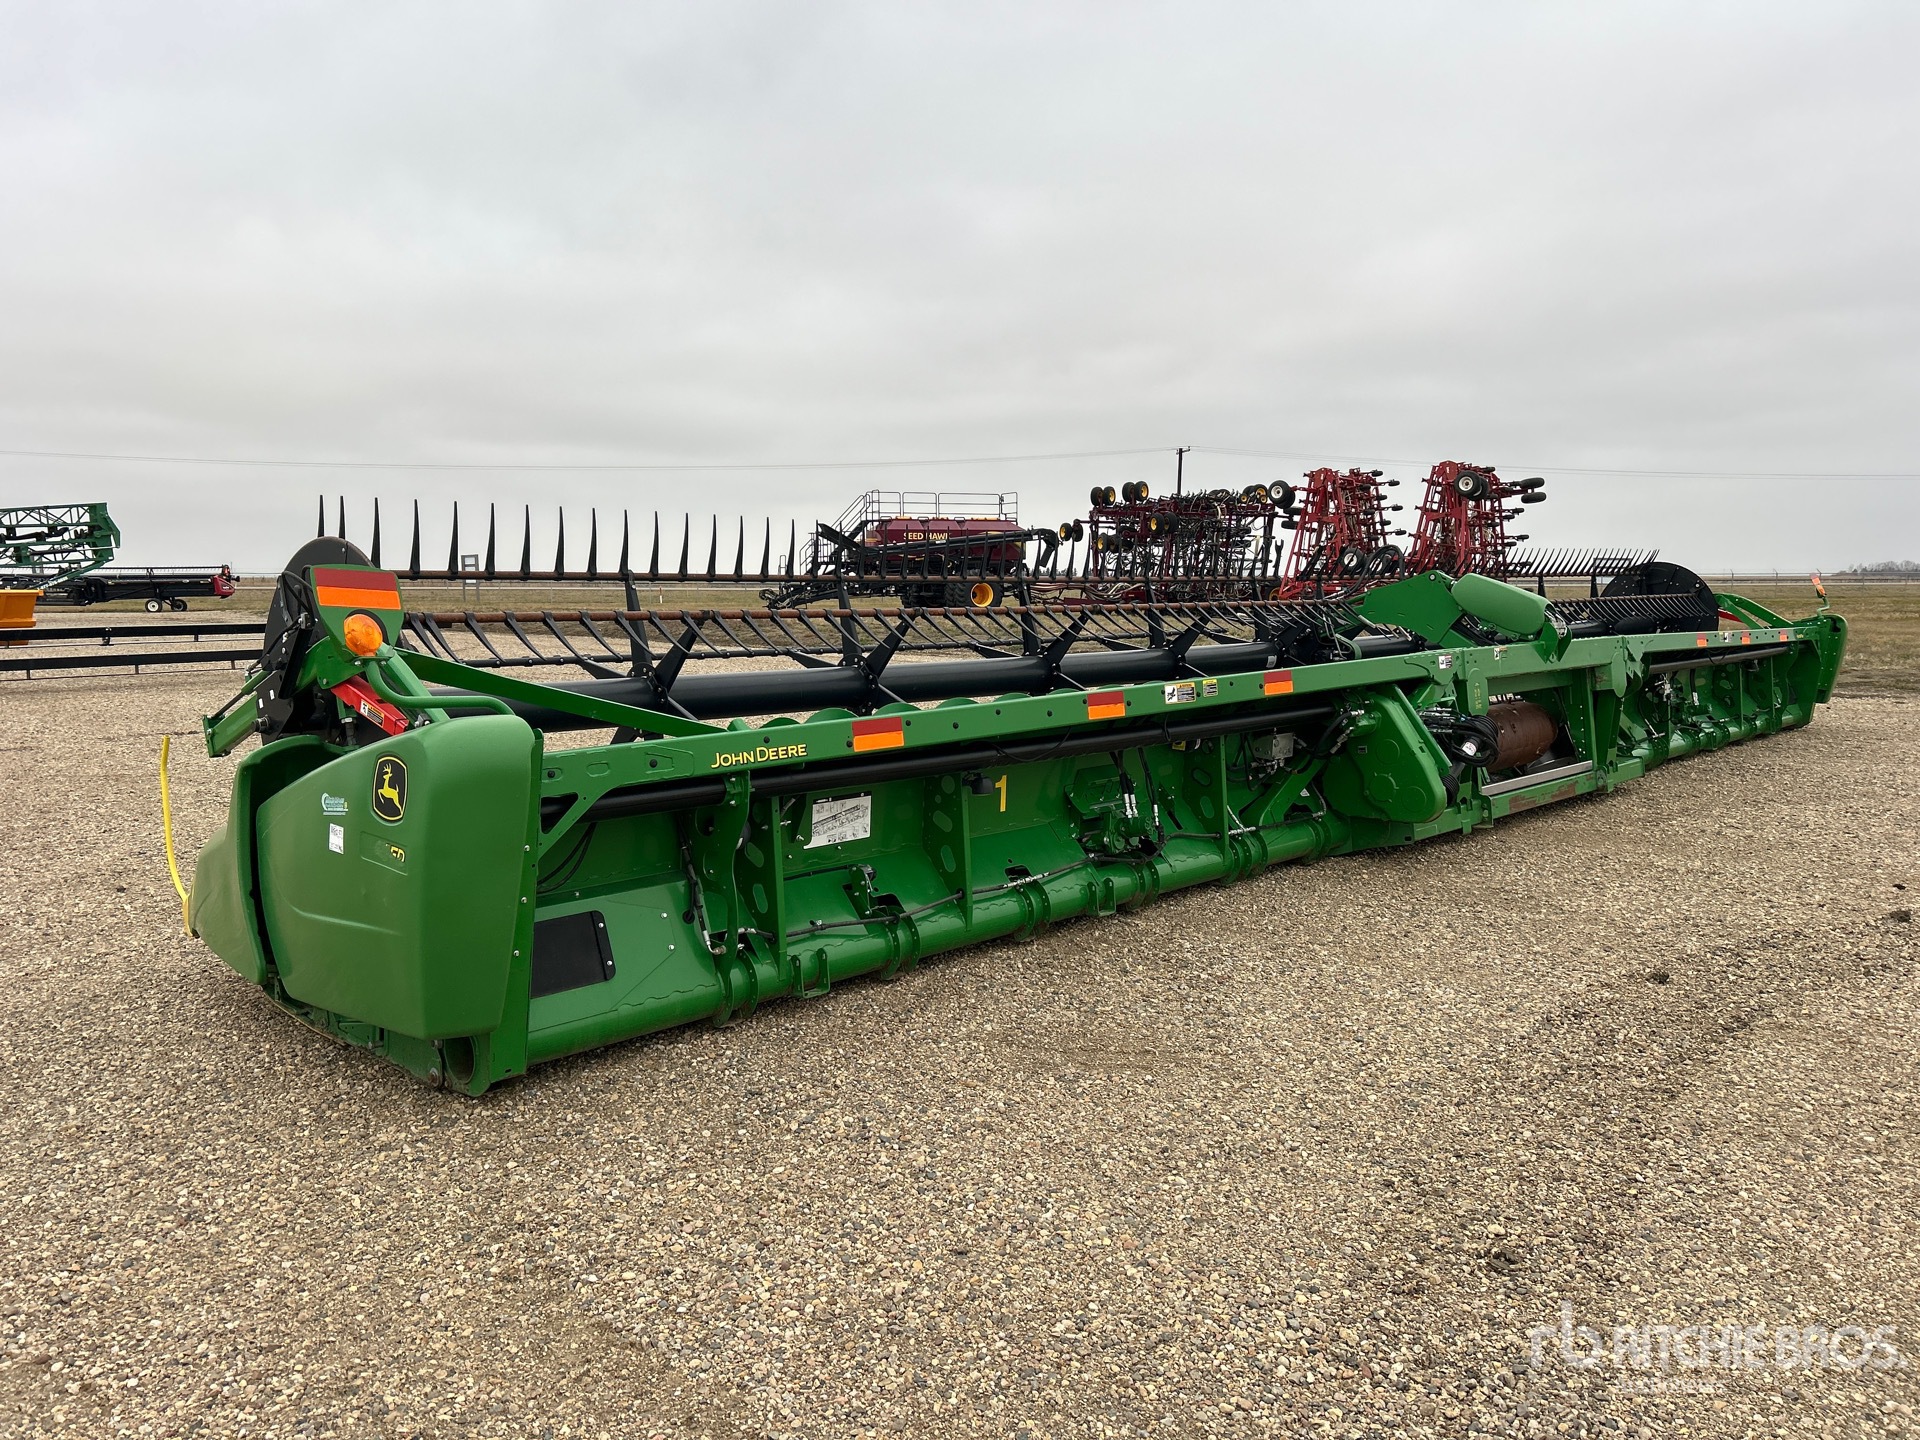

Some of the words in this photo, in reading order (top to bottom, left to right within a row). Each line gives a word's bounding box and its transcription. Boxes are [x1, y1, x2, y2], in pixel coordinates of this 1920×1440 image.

[903, 532, 924, 540] SEED
[710, 750, 755, 769] JOHN
[756, 743, 808, 762] DEERE
[994, 774, 1008, 813] 1
